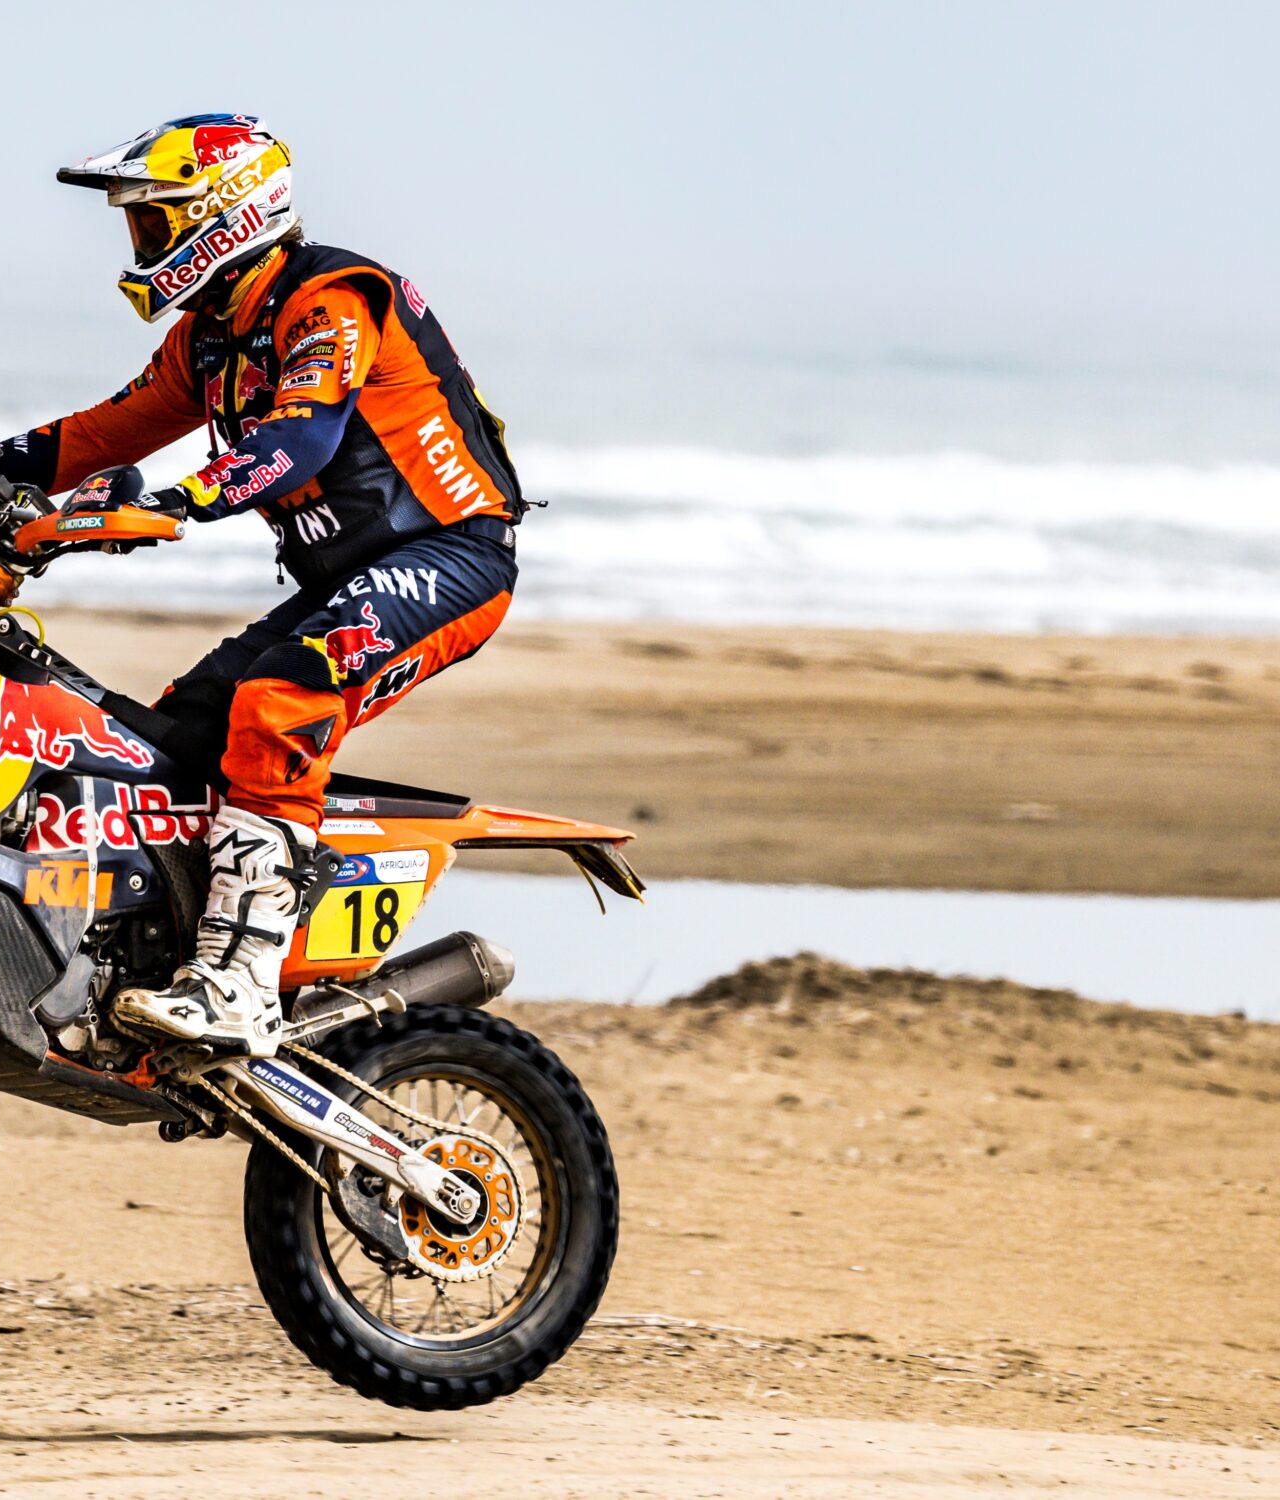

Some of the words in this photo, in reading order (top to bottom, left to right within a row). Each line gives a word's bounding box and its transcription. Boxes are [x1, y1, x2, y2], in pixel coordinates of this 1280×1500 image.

[187, 165, 264, 220] OAKLEY
[268, 183, 289, 205] BELL
[289, 374, 314, 384] ARB
[417, 415, 493, 517] KENNY
[65, 517, 102, 529] MOTOREX
[327, 567, 438, 608] KENNY
[23, 860, 115, 910] KTM
[379, 859, 418, 871] AFRIQUIA
[344, 887, 400, 954] 18
[252, 1064, 322, 1109] MICHELIN
